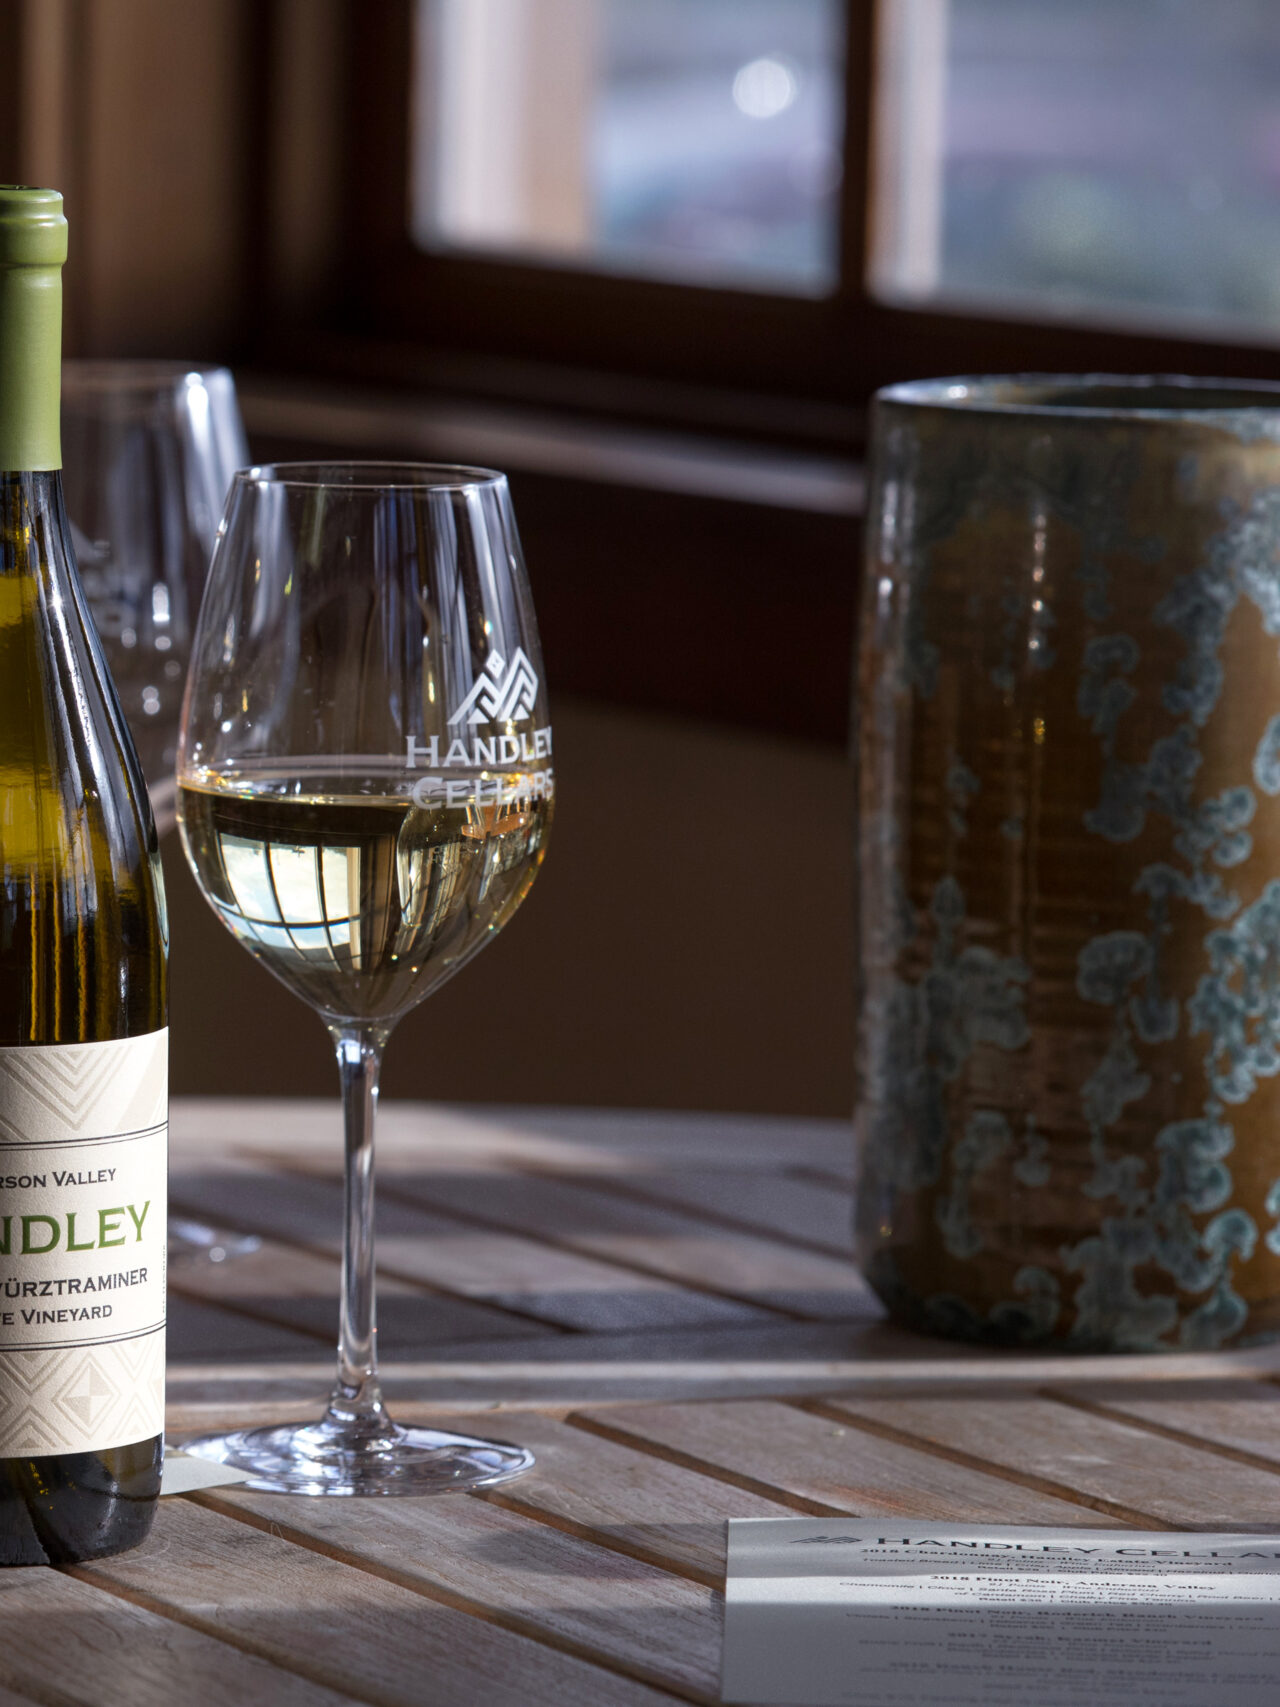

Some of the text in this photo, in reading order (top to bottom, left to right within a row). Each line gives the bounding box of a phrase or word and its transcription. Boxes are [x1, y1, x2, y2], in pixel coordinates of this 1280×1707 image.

[411, 768, 554, 810] CELLARS
[52, 1167, 117, 1187] VALLEY
[21, 1304, 113, 1326] VINEYARD
[877, 1537, 1280, 1559] HANDLEY CELLA
